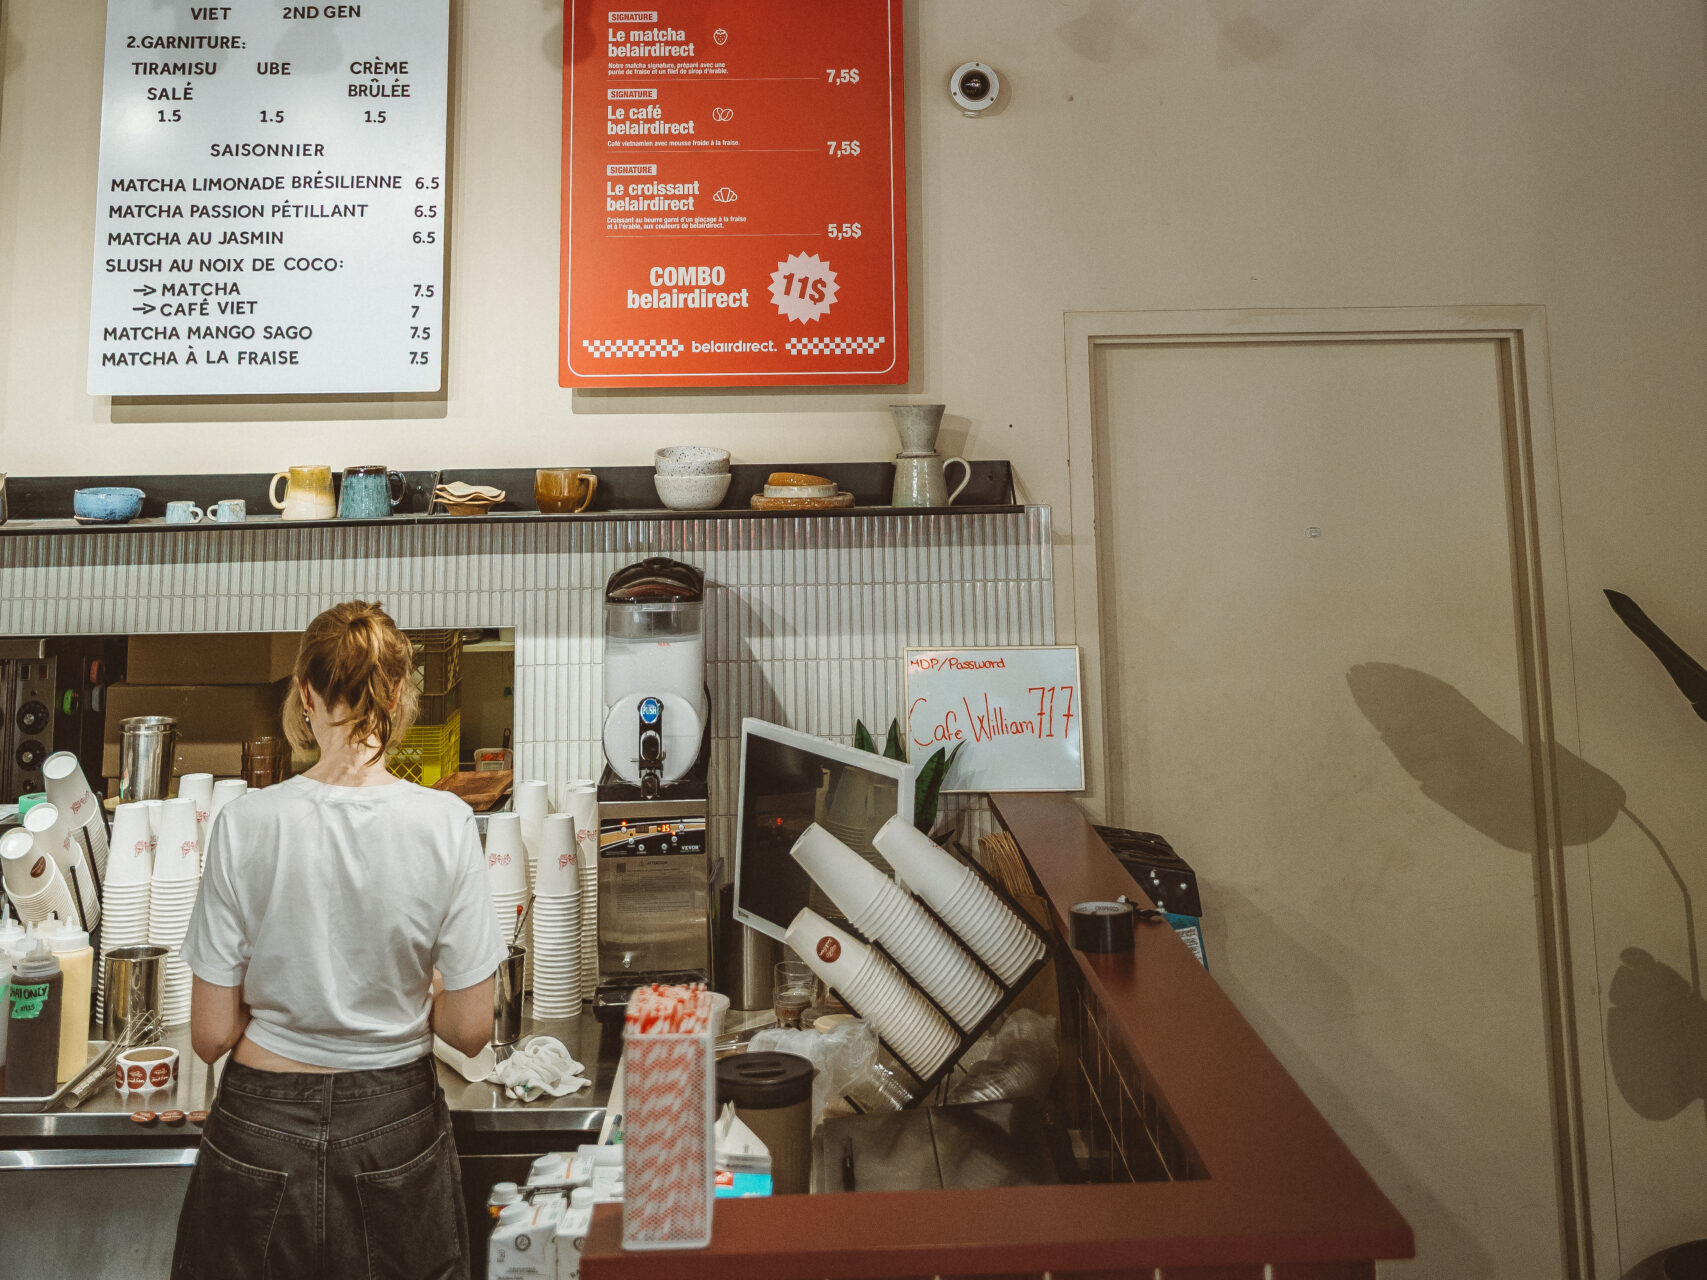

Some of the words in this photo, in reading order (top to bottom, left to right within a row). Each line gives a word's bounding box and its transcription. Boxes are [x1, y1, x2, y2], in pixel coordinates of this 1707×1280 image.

[191, 7, 231, 20] VIET
[283, 6, 319, 19] 2ND
[324, 5, 360, 18] GEN
[612, 13, 653, 21] SIGNATURE
[609, 28, 625, 41] Le
[630, 28, 685, 41] matcha
[127, 36, 245, 49] 2.GARNITURE:
[608, 43, 694, 57] belairdirect
[132, 62, 216, 75] TIRAMISU
[257, 62, 290, 75] UBE
[350, 57, 408, 74] CRÈME
[827, 68, 859, 85] 7,5$
[147, 82, 193, 100] SALÉ
[349, 78, 410, 97] BRÛLÉE
[611, 90, 653, 99] SIGNATURE
[158, 110, 181, 122] 1.5
[260, 111, 283, 123] 1.5
[365, 111, 386, 123] 1.5
[608, 106, 624, 119] Le
[629, 105, 661, 119] café
[608, 121, 694, 134] belairdirect
[211, 144, 324, 157] SAISONNIER
[827, 140, 860, 157] 7,5$
[610, 166, 652, 174] SIGNATURE
[111, 179, 186, 192] MATCHA
[193, 177, 284, 191] LIMONADE
[292, 171, 401, 189] BRÉSILIENNE
[416, 177, 439, 189] 6.5
[607, 182, 624, 195] Le
[629, 181, 699, 195] croissant
[109, 205, 183, 218] MATCHA
[191, 205, 264, 218] PASSION
[272, 200, 368, 217] PÉTILLANT
[415, 205, 436, 218] 6.5
[607, 197, 694, 211] belairdirect
[108, 233, 181, 245] MATCHA
[187, 232, 211, 245] AU
[218, 232, 283, 244] JASMIN
[413, 232, 435, 243] 6.5
[828, 223, 861, 240] 5,5$
[106, 259, 161, 272] SLUSH
[169, 259, 193, 272] AU
[200, 259, 244, 272] NOIX
[253, 258, 275, 271] DE
[284, 258, 343, 271] COCO:
[650, 266, 725, 286] COMBO
[162, 282, 240, 296] MATCHA
[414, 285, 434, 297] 7.5
[782, 272, 827, 306] 11$
[627, 289, 748, 308] belairdirect
[160, 298, 209, 316] CAFÉ
[218, 301, 257, 314] VIET
[412, 306, 419, 318] 7
[104, 327, 180, 341] MATCHA
[188, 326, 255, 339] MANGO
[263, 326, 312, 339] SAGO
[411, 327, 430, 340] 7.5
[692, 340, 777, 352] belairdirect.
[102, 352, 178, 366] MATCHA
[186, 345, 197, 364] À
[207, 351, 228, 364] LA
[238, 351, 298, 365] FRAISE
[410, 352, 428, 364] 7.5
[642, 704, 656, 714] PUSH
[963, 692, 1034, 743] William
